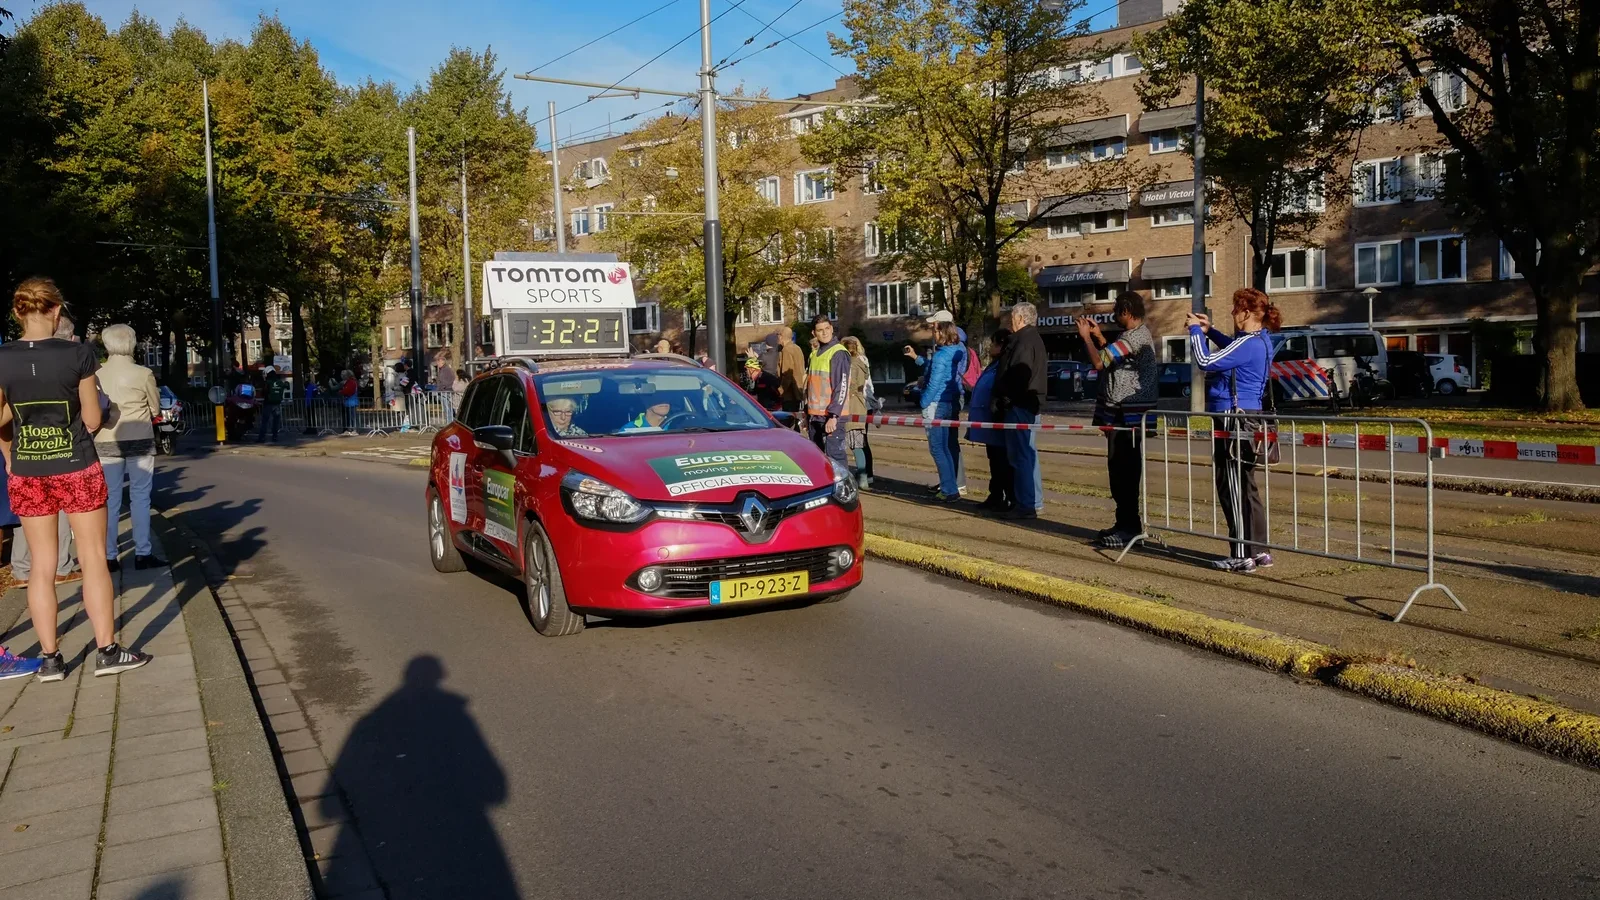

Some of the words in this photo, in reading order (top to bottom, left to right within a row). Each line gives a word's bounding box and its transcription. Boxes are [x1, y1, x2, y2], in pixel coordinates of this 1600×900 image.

[1144, 192, 1166, 202] Hotel
[1169, 188, 1194, 199] Victori
[491, 267, 607, 283] TOMTOM
[1055, 273, 1075, 282] Hotel
[1076, 271, 1104, 281] Victorie
[526, 288, 603, 303] SPORTS
[1037, 315, 1076, 326] HOTEL
[1081, 312, 1116, 324] VICTO
[21, 424, 64, 439] Hogan
[22, 436, 68, 449] Lovells
[42, 452, 73, 460] Damloop
[675, 453, 772, 467] Europcar
[1516, 449, 1533, 457] NIET
[1536, 450, 1579, 460] BETREDEN
[683, 465, 728, 476] moving
[759, 464, 783, 472] way
[486, 477, 510, 500] Europcar
[669, 476, 734, 495] OFFICIAL
[739, 475, 811, 485] SPONSOR
[729, 575, 801, 599] JP-923-Z
